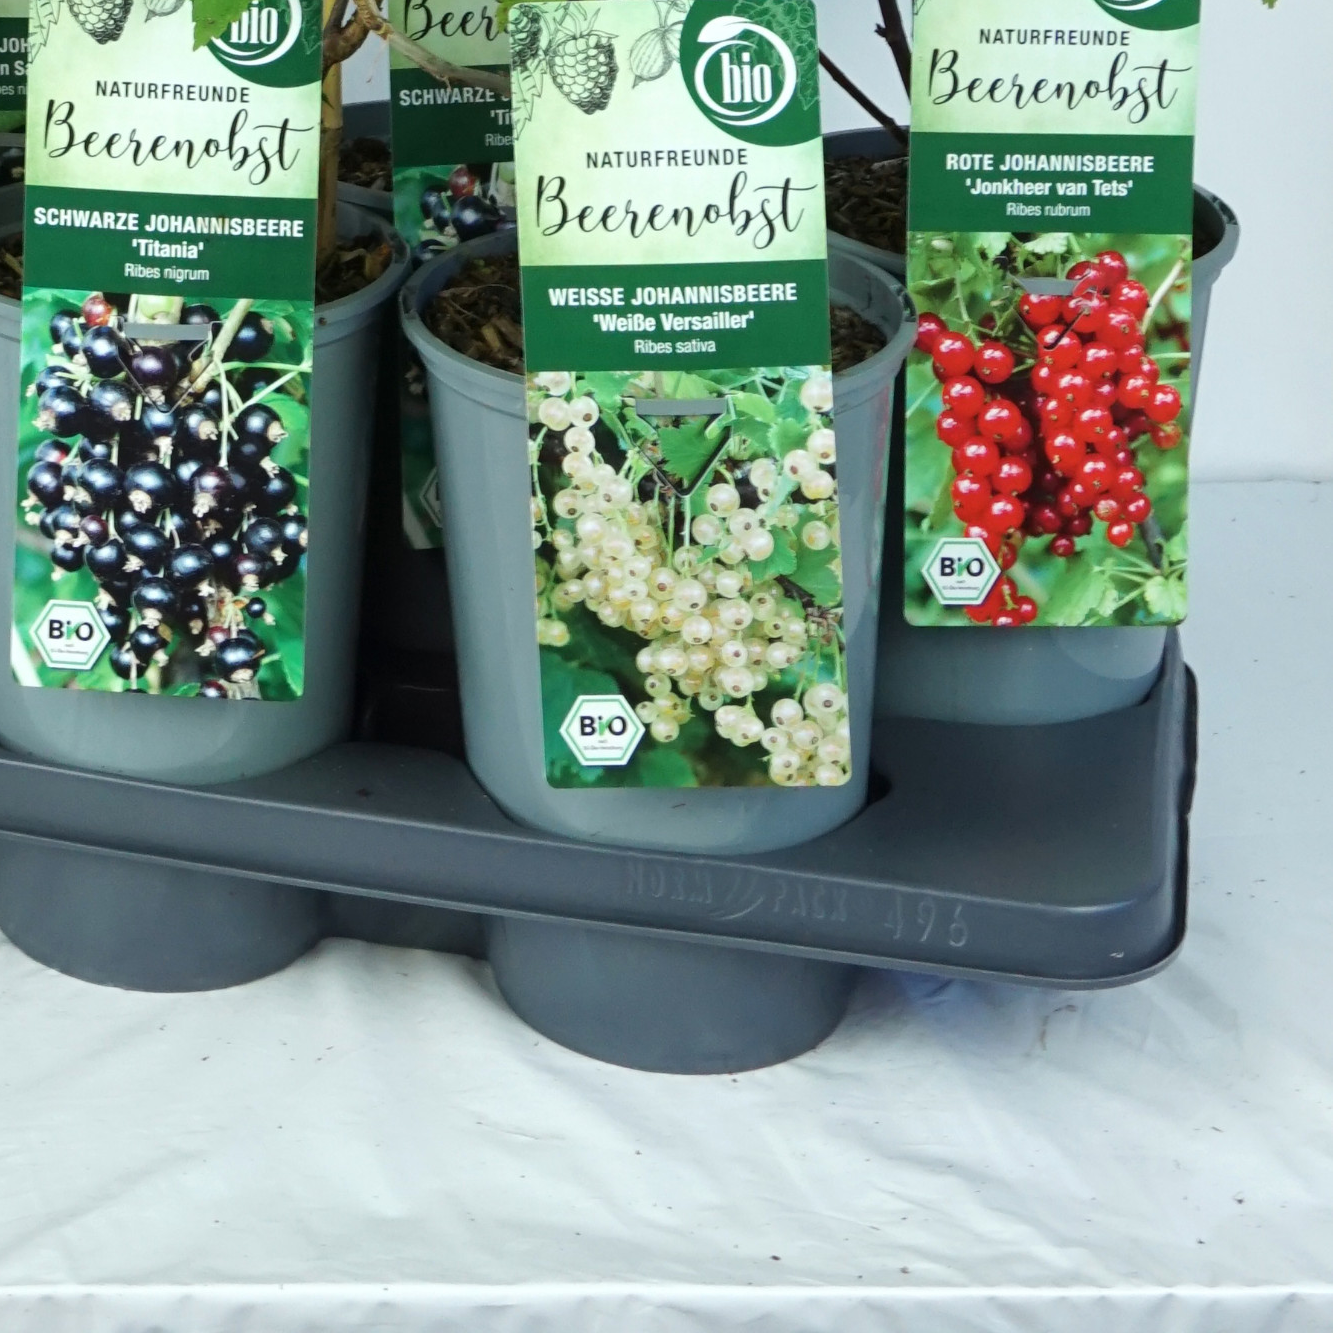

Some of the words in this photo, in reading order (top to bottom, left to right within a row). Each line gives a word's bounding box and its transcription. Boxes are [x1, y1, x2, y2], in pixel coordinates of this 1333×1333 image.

[979, 28, 1131, 46] NATURFREUNDE
[720, 51, 772, 104] bio
[929, 48, 1193, 124] Beerenobst
[95, 80, 250, 103] NATURFREUNDE
[399, 87, 495, 106] SCHWARZE
[44, 99, 314, 185] Beerenobst
[586, 148, 748, 169] NATURFREUNDE
[946, 153, 994, 171] ROTE
[999, 154, 1155, 173] JOHANNISBEERE
[966, 178, 1051, 196] 'Jonkheer
[1056, 182, 1087, 196] van
[536, 171, 818, 250] Beerenobst
[1006, 203, 1042, 217] Ribes
[1045, 203, 1091, 217] rubrum
[34, 207, 139, 231] SCHWARZE
[145, 214, 304, 238] JOHANNISBEERE
[132, 239, 204, 259] 'Titania'
[124, 263, 161, 279] Ribes
[163, 265, 210, 282] nigrum
[548, 287, 625, 306] WEISSE
[631, 282, 798, 305] JOHANNISBEERE
[660, 310, 755, 332] Versailler'
[634, 339, 672, 355] Ribes
[675, 338, 716, 354] sativa
